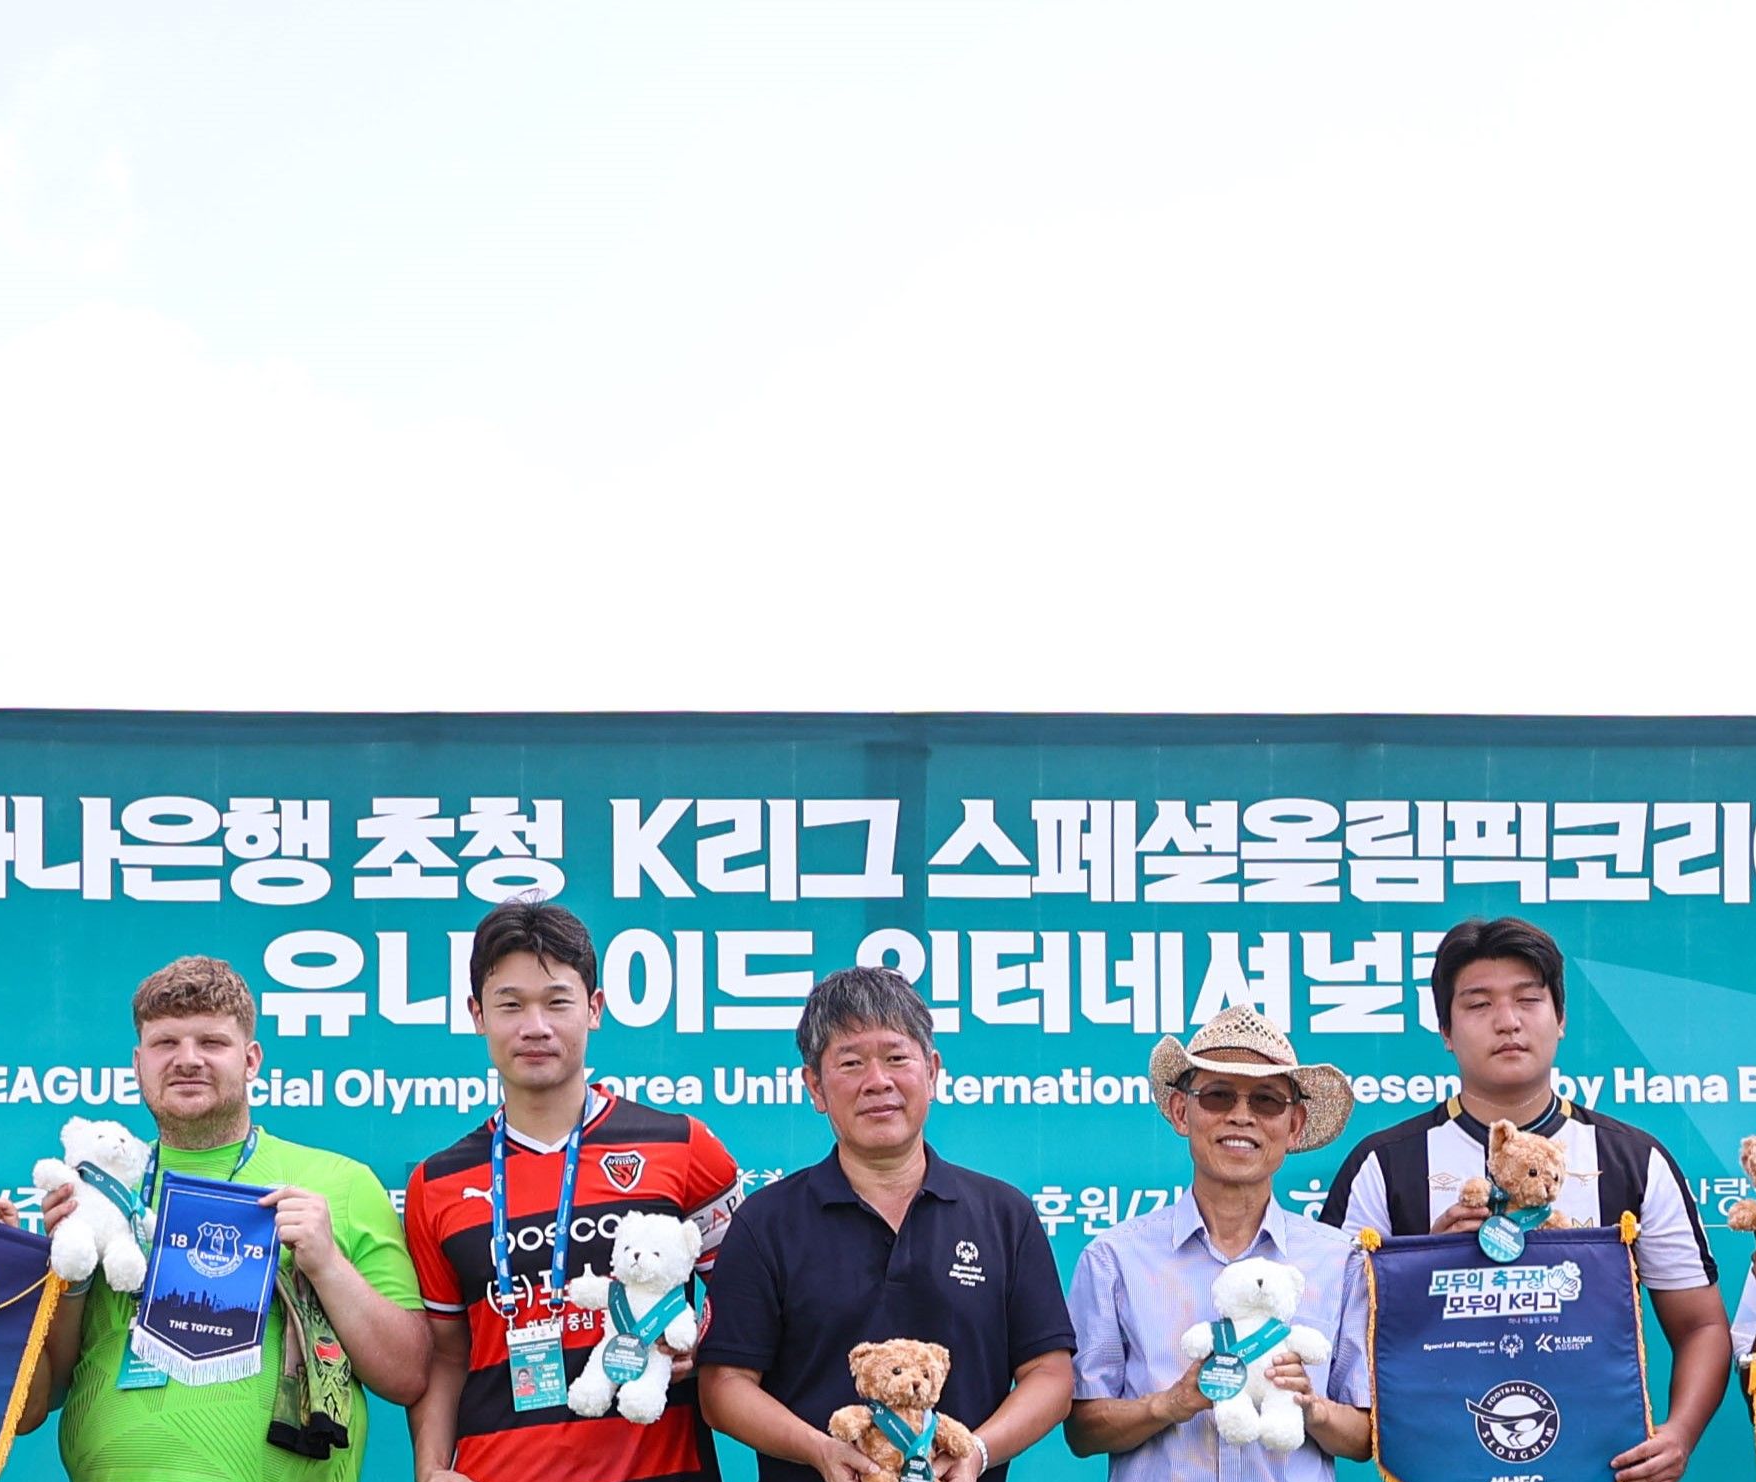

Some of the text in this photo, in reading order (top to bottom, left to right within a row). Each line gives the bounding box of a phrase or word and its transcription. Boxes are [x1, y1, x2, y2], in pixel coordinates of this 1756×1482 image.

[354, 797, 566, 904] 초청
[612, 798, 904, 901] K리그
[262, 930, 817, 1035] 유니이드
[250, 1068, 324, 1106] cial
[335, 1068, 505, 1114] Olympi
[584, 1065, 695, 1105] orea
[714, 1067, 814, 1105] Unif
[932, 1067, 1155, 1106] ternation
[1552, 1065, 1602, 1111] by
[1615, 1066, 1730, 1104] Hana
[170, 1234, 187, 1247] 18
[243, 1245, 263, 1259] 78
[1433, 1270, 1546, 1292] 모두의 축구장
[1448, 1293, 1559, 1314] 모두의 K리그
[169, 1320, 233, 1337] THE TOFFEES
[1487, 1386, 1548, 1406] FOOTBALL CLUB
[1481, 1427, 1555, 1460] SEONGNAM
